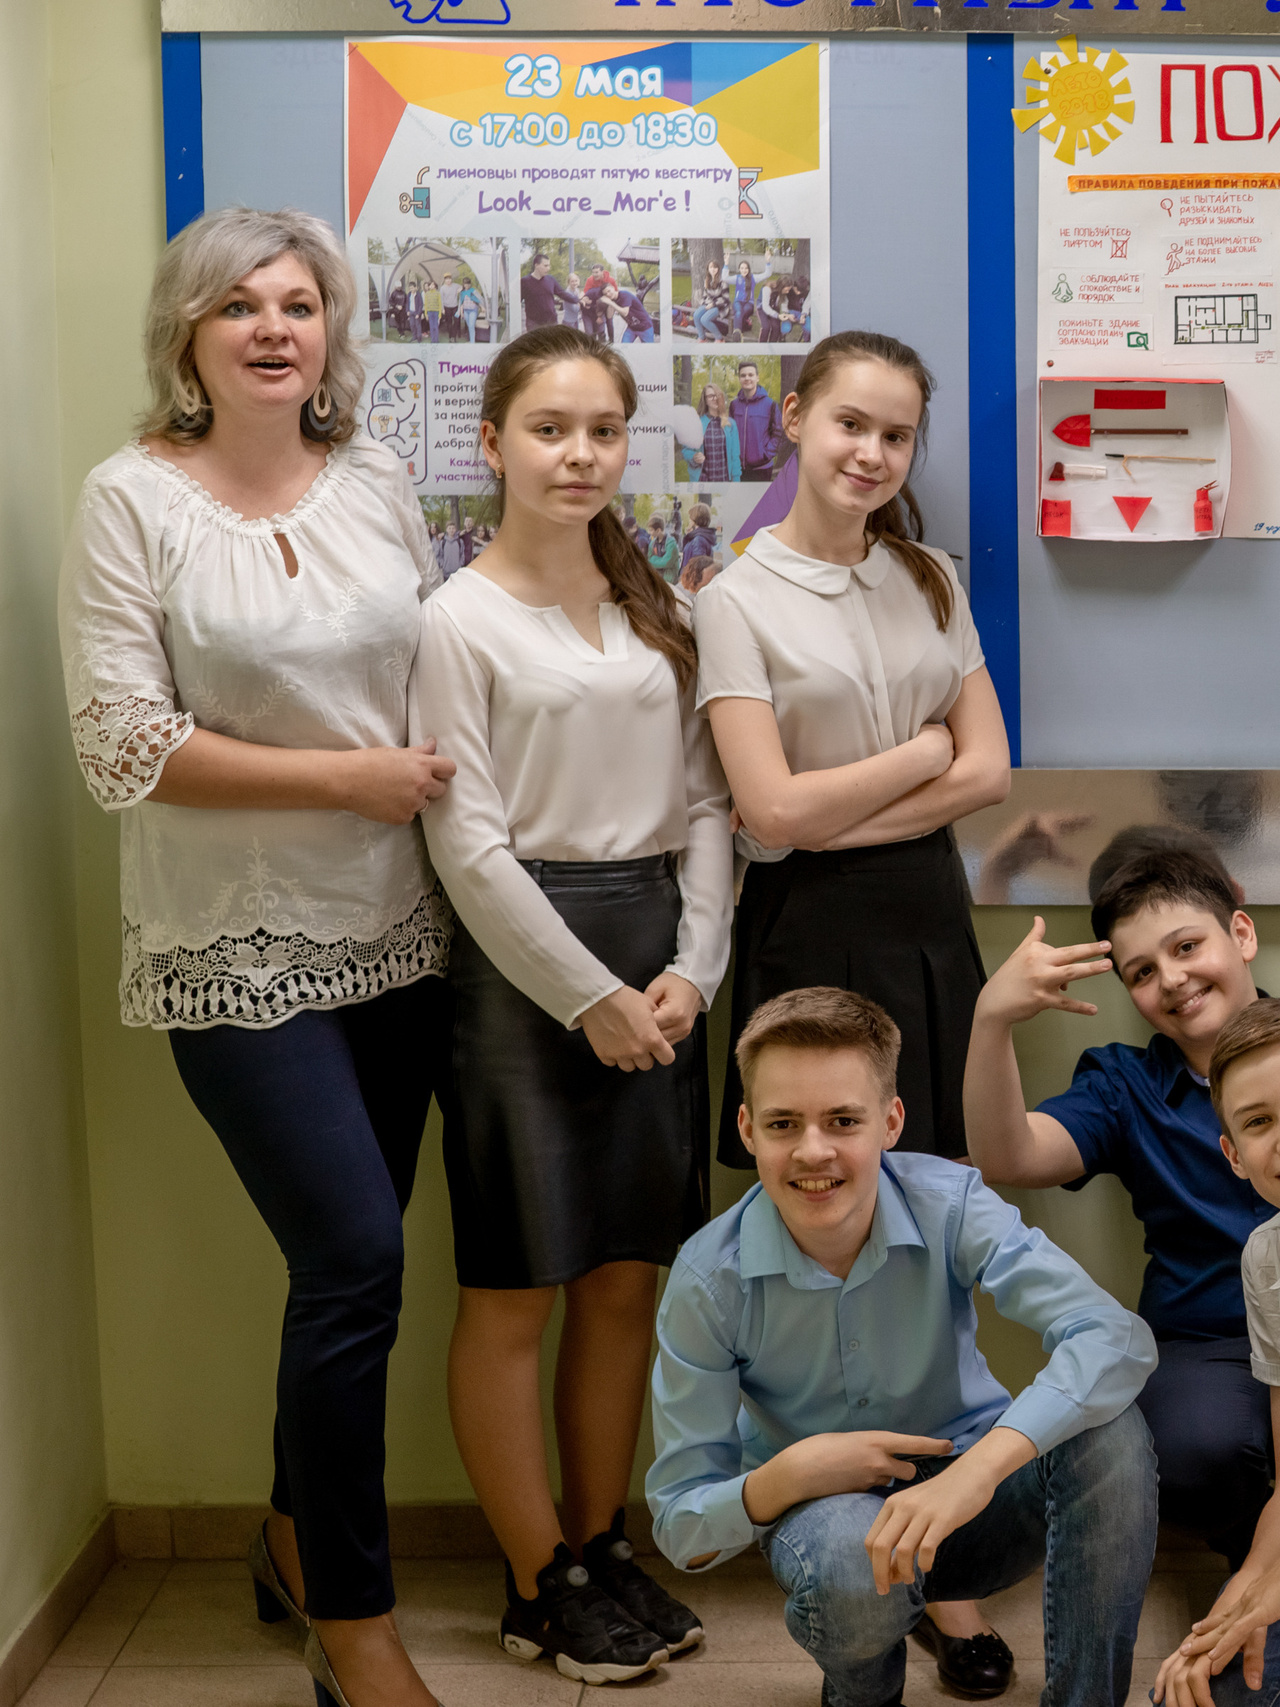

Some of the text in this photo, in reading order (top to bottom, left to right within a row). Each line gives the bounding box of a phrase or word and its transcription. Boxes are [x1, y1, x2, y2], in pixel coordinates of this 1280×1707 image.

[504, 54, 664, 100] 23 мая
[1059, 89, 1111, 119] 2018
[479, 112, 569, 147] 17:00
[577, 121, 625, 150] до
[632, 111, 718, 148] 18:30
[437, 168, 733, 183] лиеновцы проводят пятую квестигру
[1078, 180, 1134, 189] ПРАВИЛА
[1139, 179, 1211, 190] ПОВЕДЕНИЯ
[1215, 179, 1238, 189] ПРИ
[1180, 192, 1254, 204] НЕ ПЫТАЙТЕСЬ
[1179, 214, 1207, 226] ДРУЗЕЙ
[1217, 217, 1255, 225] ЗНАКОМЫХ
[1060, 225, 1131, 237] НЕ ПОЛЬЗУЙТЕСЬ
[1063, 240, 1103, 248] ЛИФТОМ
[1185, 236, 1262, 247] НЕ ПОДНИМАЙТЕСЬ
[1185, 248, 1195, 256] НА
[1081, 274, 1140, 283] СОБЛЮДАЙТЕ
[1059, 319, 1140, 328] ПОКИНЬТЕ ЗДАНИЕ
[1059, 338, 1109, 346] ЭВАКУАЦИИ
[434, 382, 667, 394] пройти ации
[434, 412, 481, 420] за наим
[448, 424, 479, 434] Побе
[434, 438, 473, 450] добра
[449, 458, 489, 468] Кажда
[435, 474, 492, 483] участнико
